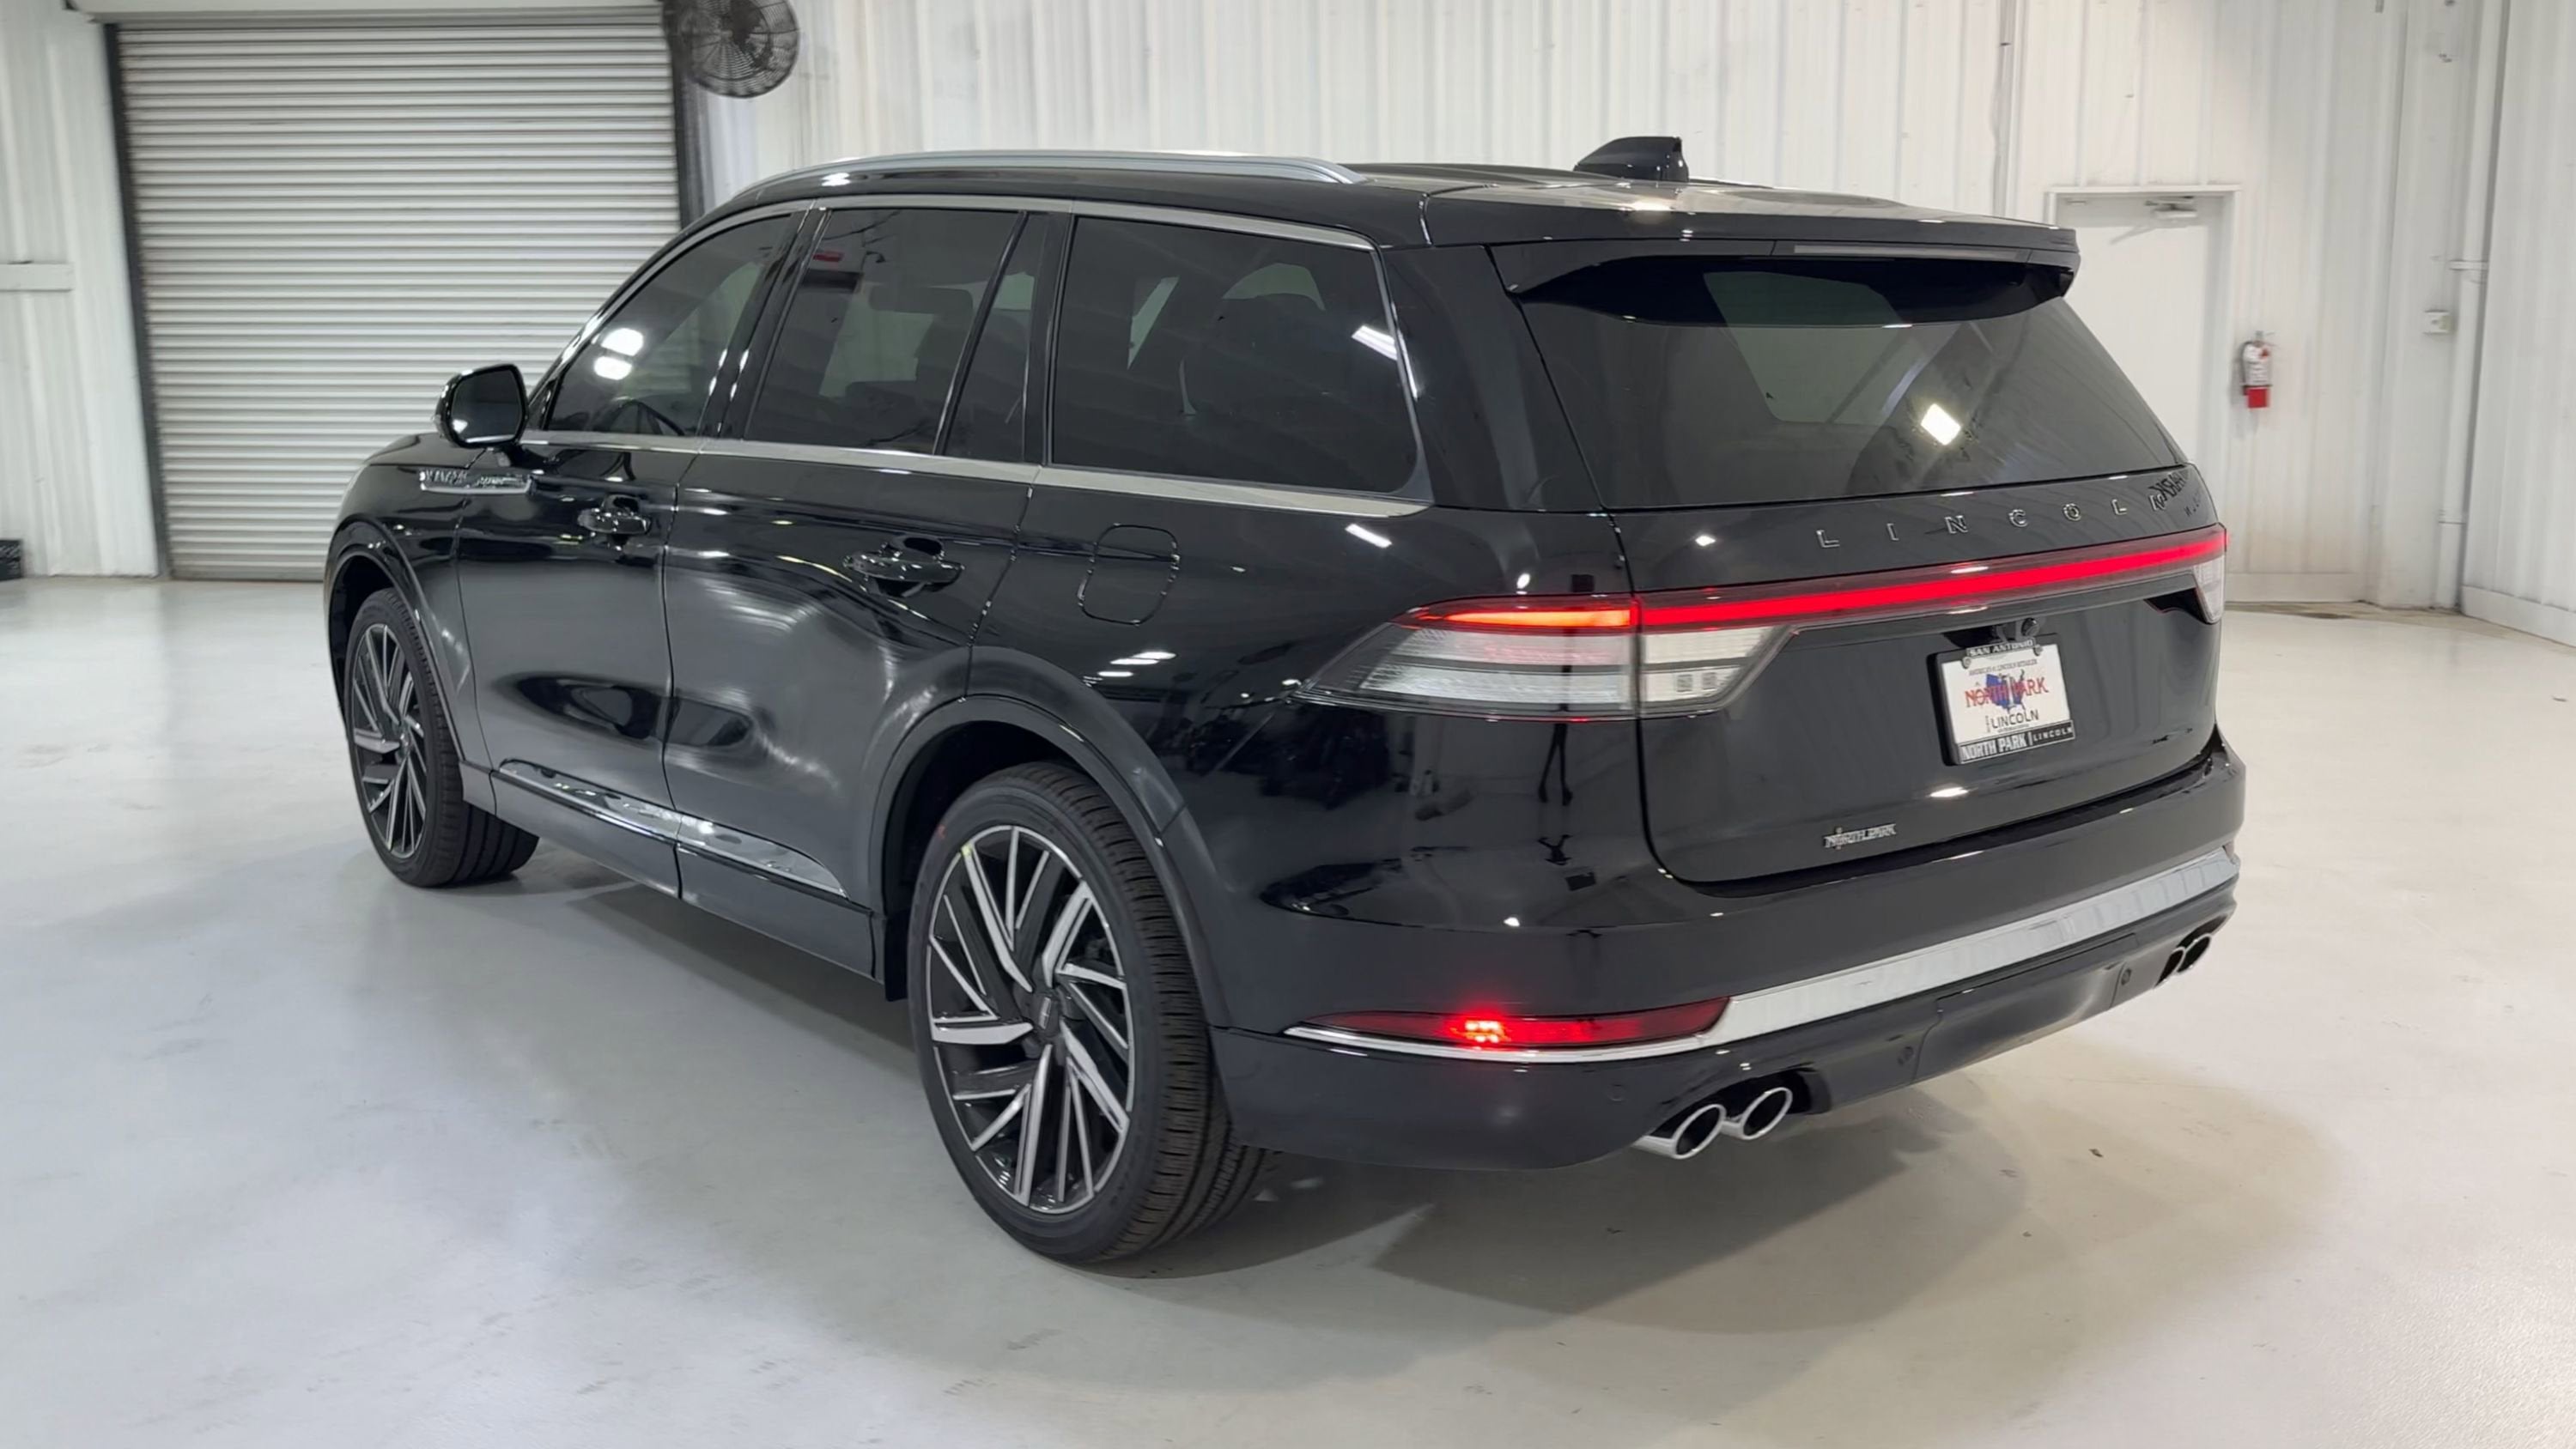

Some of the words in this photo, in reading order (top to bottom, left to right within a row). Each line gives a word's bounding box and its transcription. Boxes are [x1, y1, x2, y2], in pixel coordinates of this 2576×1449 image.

[1816, 494, 2166, 549] LINCOLN
[1969, 647, 1990, 657] SAN
[1991, 709, 2039, 729] LINCOLN
[1960, 739, 1997, 761] NORTH
[1997, 733, 2027, 753] PARK
[2032, 727, 2073, 742] LINCOLN
